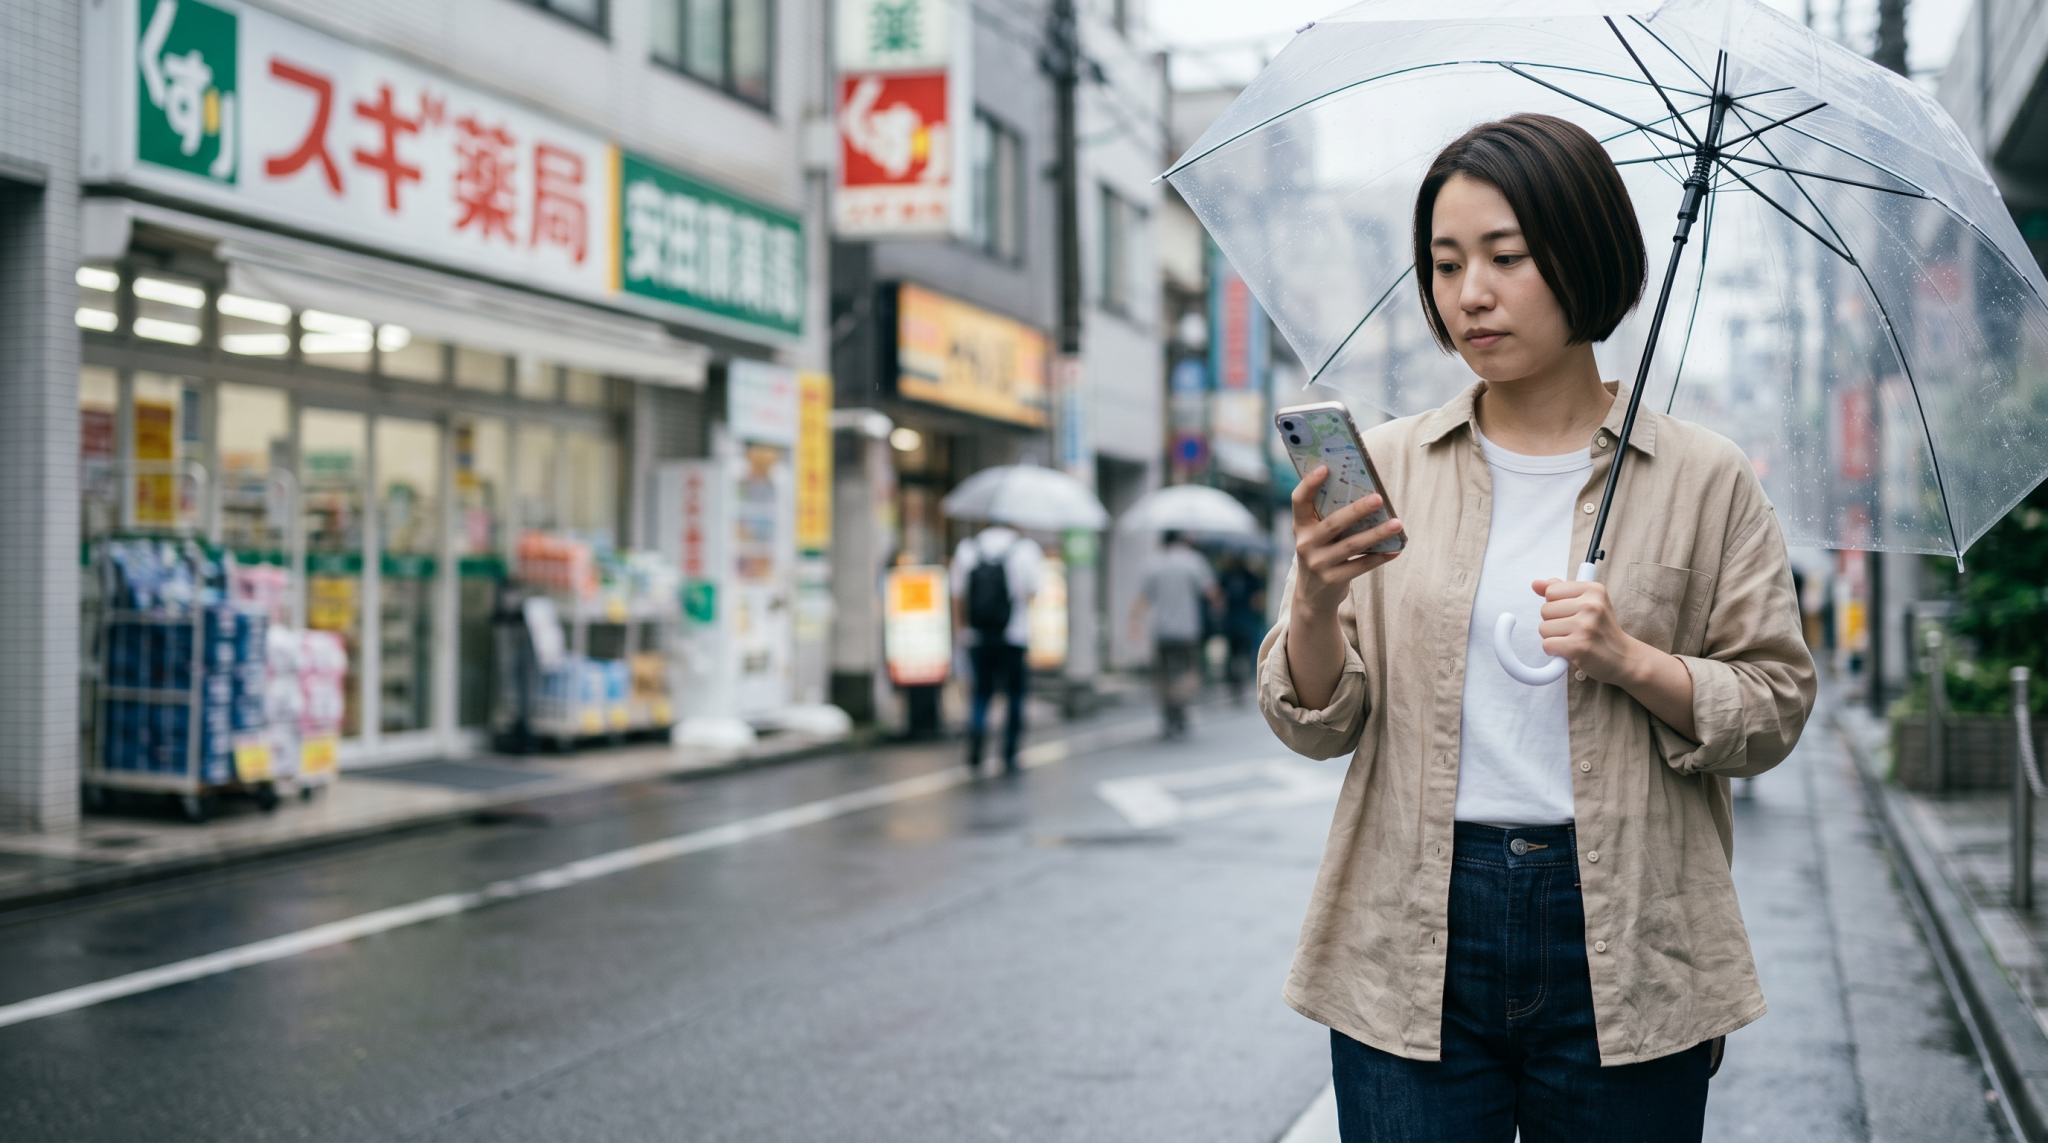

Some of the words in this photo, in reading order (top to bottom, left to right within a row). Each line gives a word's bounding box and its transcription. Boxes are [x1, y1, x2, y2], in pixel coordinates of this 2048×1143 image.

[141, 0, 235, 178] くすり
[265, 57, 588, 264] スギ薬局
